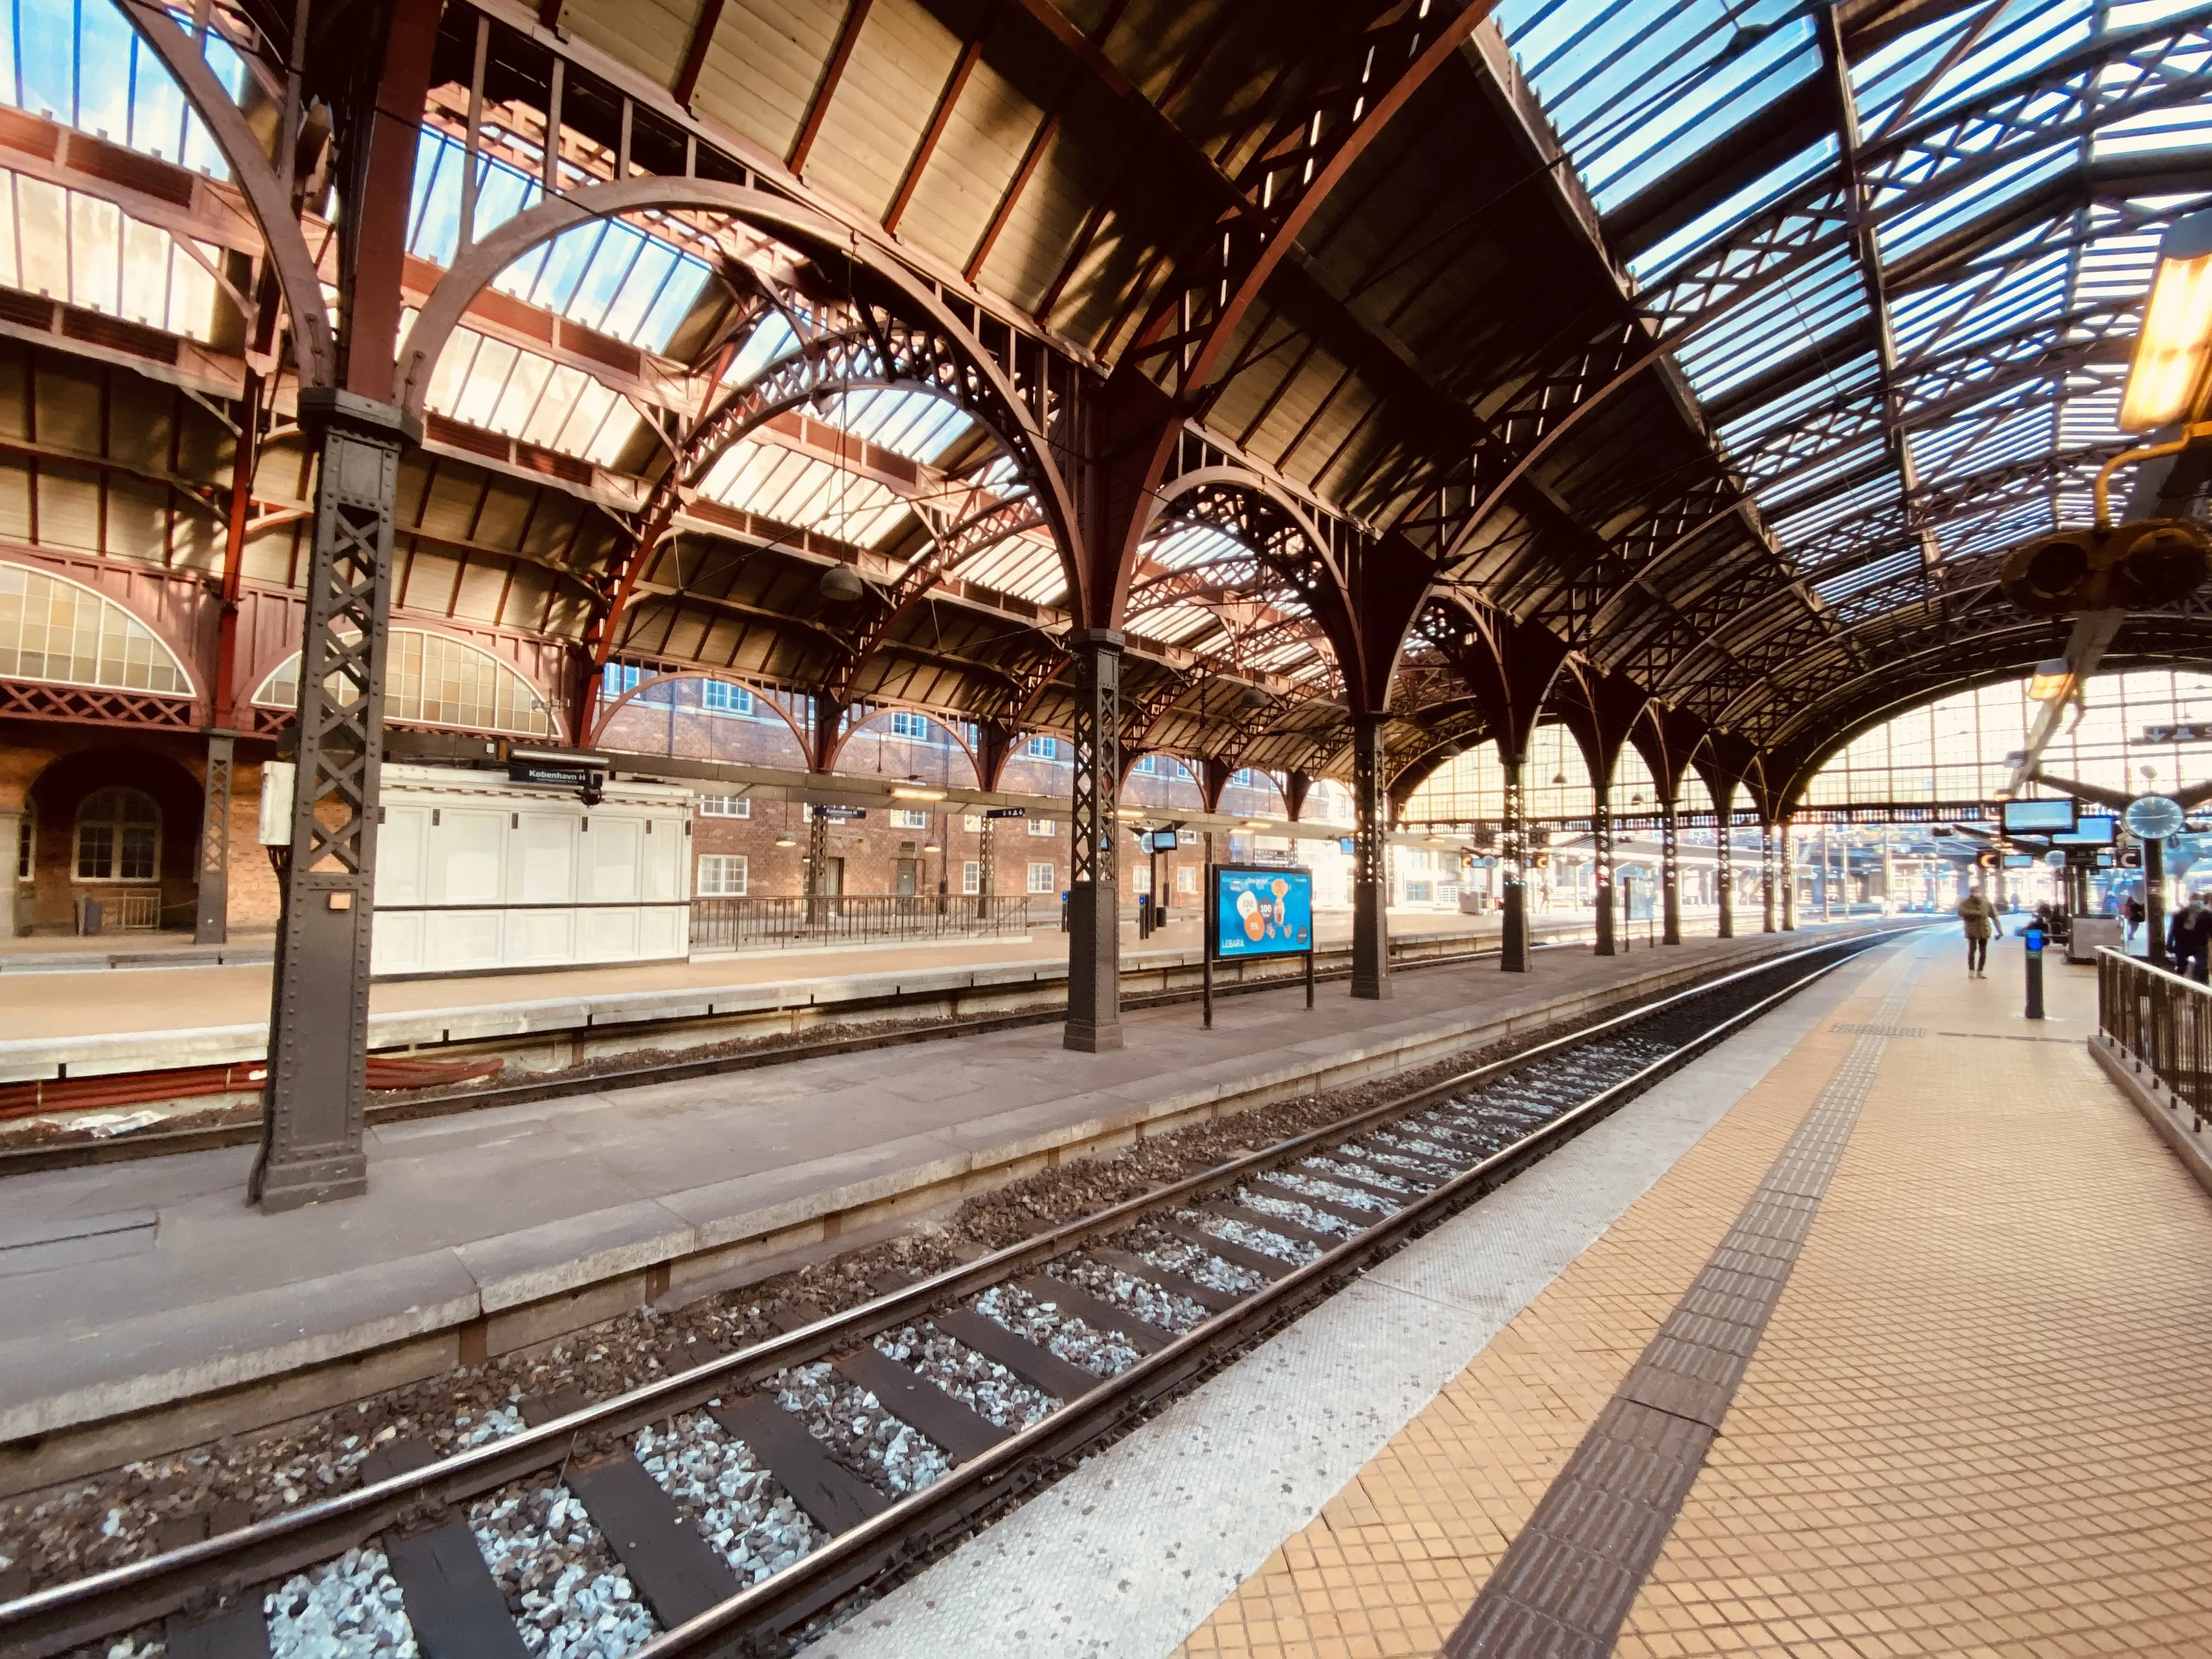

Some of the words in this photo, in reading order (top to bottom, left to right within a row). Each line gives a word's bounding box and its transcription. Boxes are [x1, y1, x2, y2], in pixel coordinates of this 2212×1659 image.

[529, 770, 576, 780] København
[1530, 831, 1548, 844] BC
[1243, 899, 1253, 907] 100
[1261, 904, 1272, 913] 100
[1221, 939, 1244, 949] LEBARA
